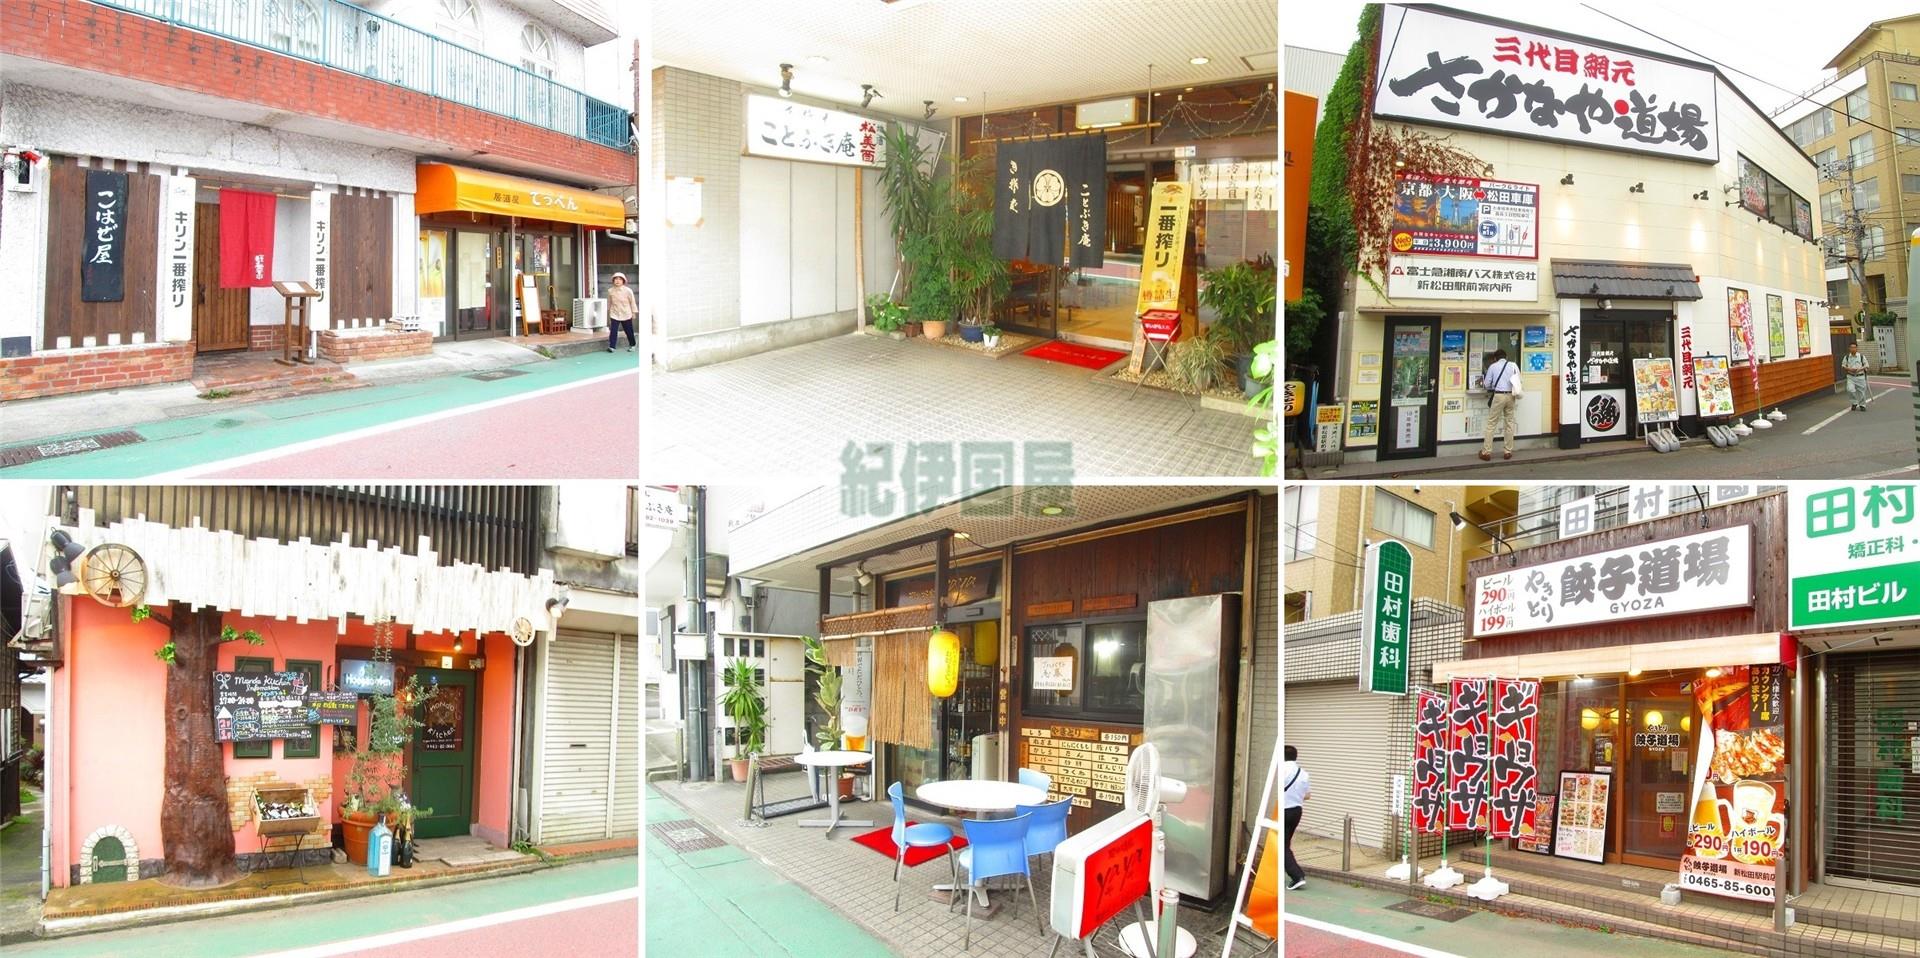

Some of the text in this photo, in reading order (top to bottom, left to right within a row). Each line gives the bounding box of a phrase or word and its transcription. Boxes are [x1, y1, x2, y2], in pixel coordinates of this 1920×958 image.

[1492, 36, 1636, 87] 三代目網元
[1388, 51, 1709, 152] さかなや道場
[1486, 189, 1534, 205] 松田車庫
[89, 190, 118, 265] こはぜ屋
[1077, 183, 1092, 248] ことぶき庵
[1154, 205, 1178, 268] 一番搾り
[171, 211, 189, 308] キリン一番搾り
[314, 220, 327, 303] キリン一番搾り
[1406, 266, 1537, 281] 富士急湘南バス株式会社
[1417, 280, 1513, 293] 新松田駅前案内所
[1563, 325, 1580, 395] さかなや道場
[1679, 326, 1694, 389] 三代目網元
[1806, 485, 1917, 538] 田村
[1482, 574, 1513, 591] ビール
[1559, 535, 1730, 608] 餃子道場
[1478, 603, 1516, 616] ハイボール
[1481, 587, 1516, 607] 290円
[1609, 596, 1665, 615] GYOZA
[1807, 580, 1908, 613] 田村ビル
[1378, 570, 1404, 669] 田村歯科
[1479, 614, 1514, 633] 199円
[1635, 733, 1681, 748] 餃子道場
[1693, 834, 1729, 852] 290円
[1731, 826, 1777, 838] ハイボール
[1693, 860, 1728, 875] 餃子道場
[1688, 874, 1776, 897] 0465-85-6001
